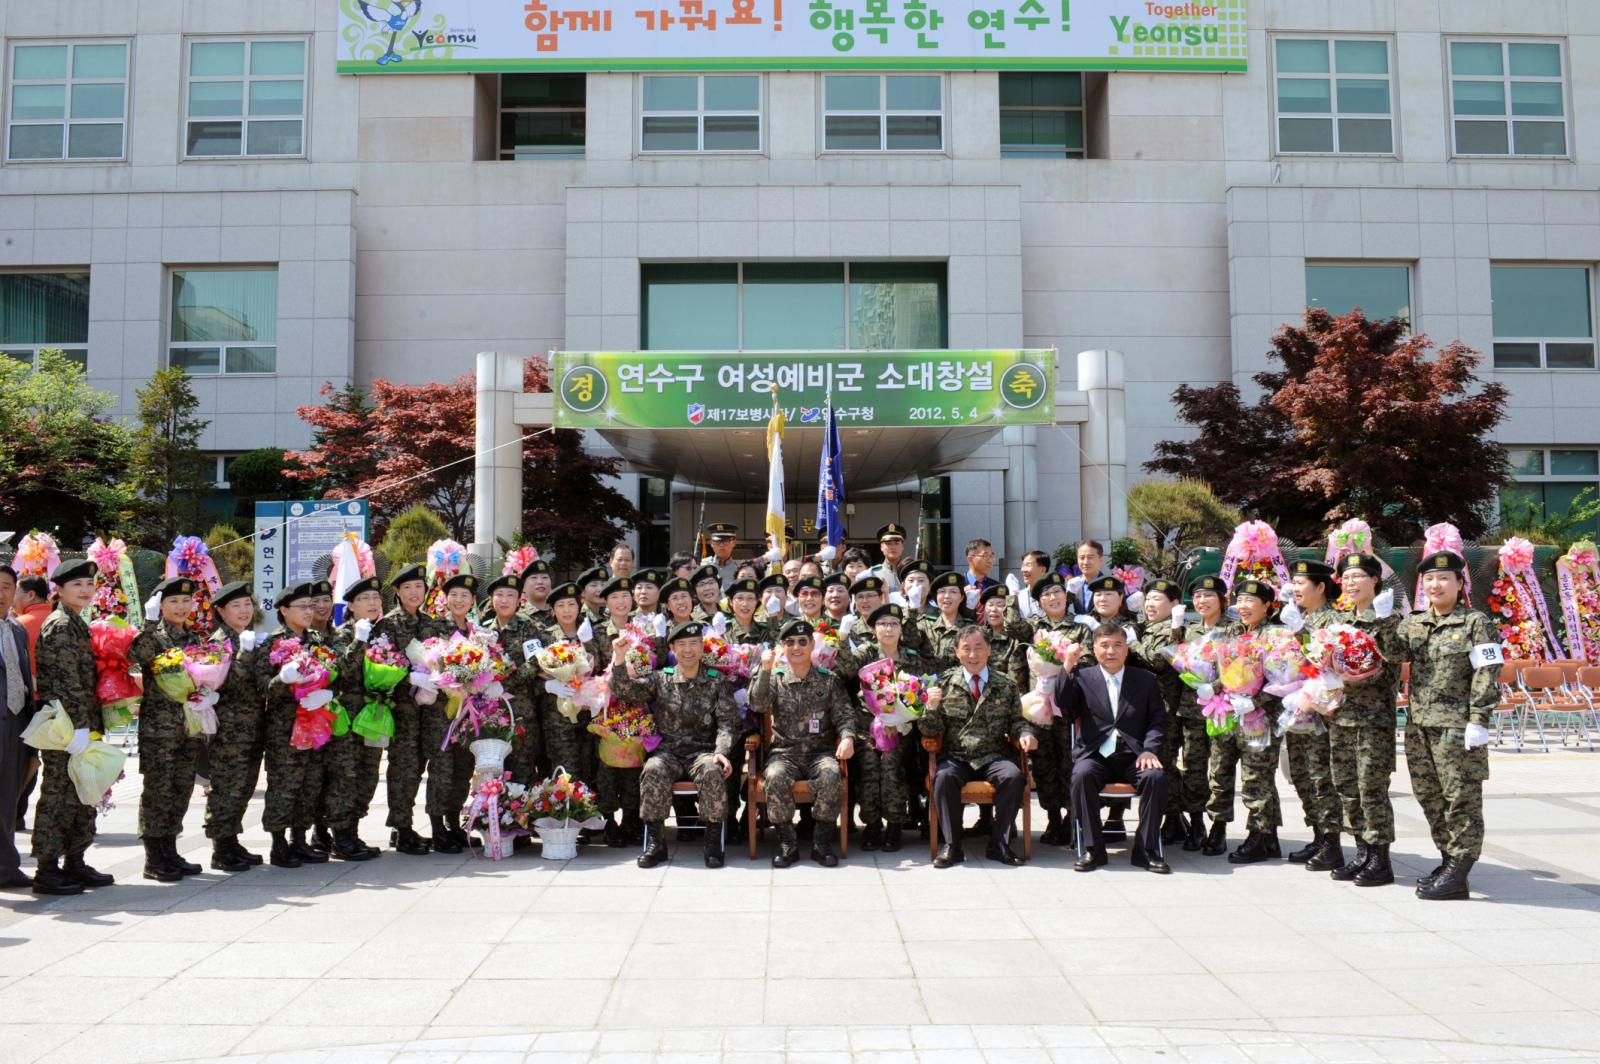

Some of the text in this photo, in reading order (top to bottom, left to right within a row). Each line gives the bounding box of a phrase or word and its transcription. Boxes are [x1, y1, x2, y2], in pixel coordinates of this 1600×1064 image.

[1145, 2, 1218, 19] Together
[411, 29, 477, 49] Yeonsu
[524, 0, 1070, 51] 함께 가꿔요! 행복한 연수!
[1109, 15, 1218, 46] Yeonsu
[569, 373, 593, 402] 경
[617, 360, 993, 394] 연수구 여성예비군 소대창설
[1008, 370, 1038, 399] 축
[909, 407, 978, 420] 2012. 5. 4
[262, 546, 275, 611] 연수구청
